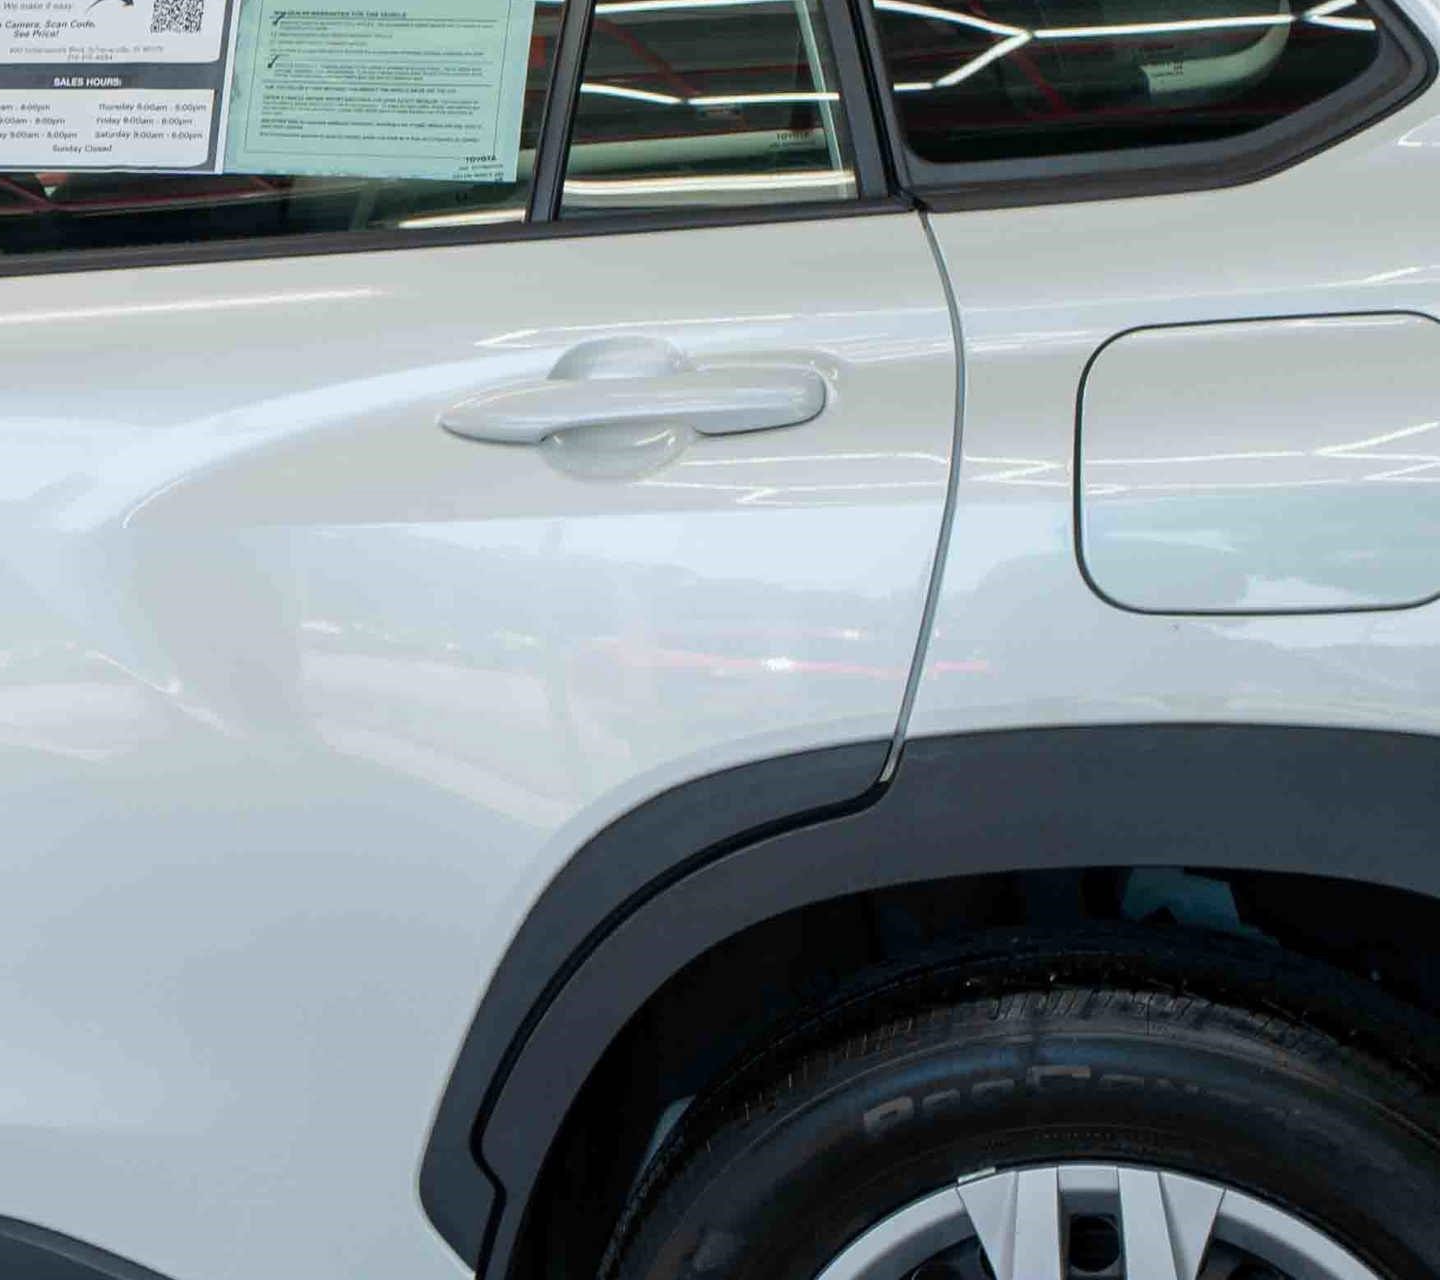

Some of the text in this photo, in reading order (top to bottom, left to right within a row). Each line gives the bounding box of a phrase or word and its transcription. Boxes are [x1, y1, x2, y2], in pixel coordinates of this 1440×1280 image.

[46, 20, 67, 28] Scan
[14, 30, 29, 38] See
[53, 76, 122, 87] SALES HOURS:
[52, 144, 112, 153] Sunday Closed
